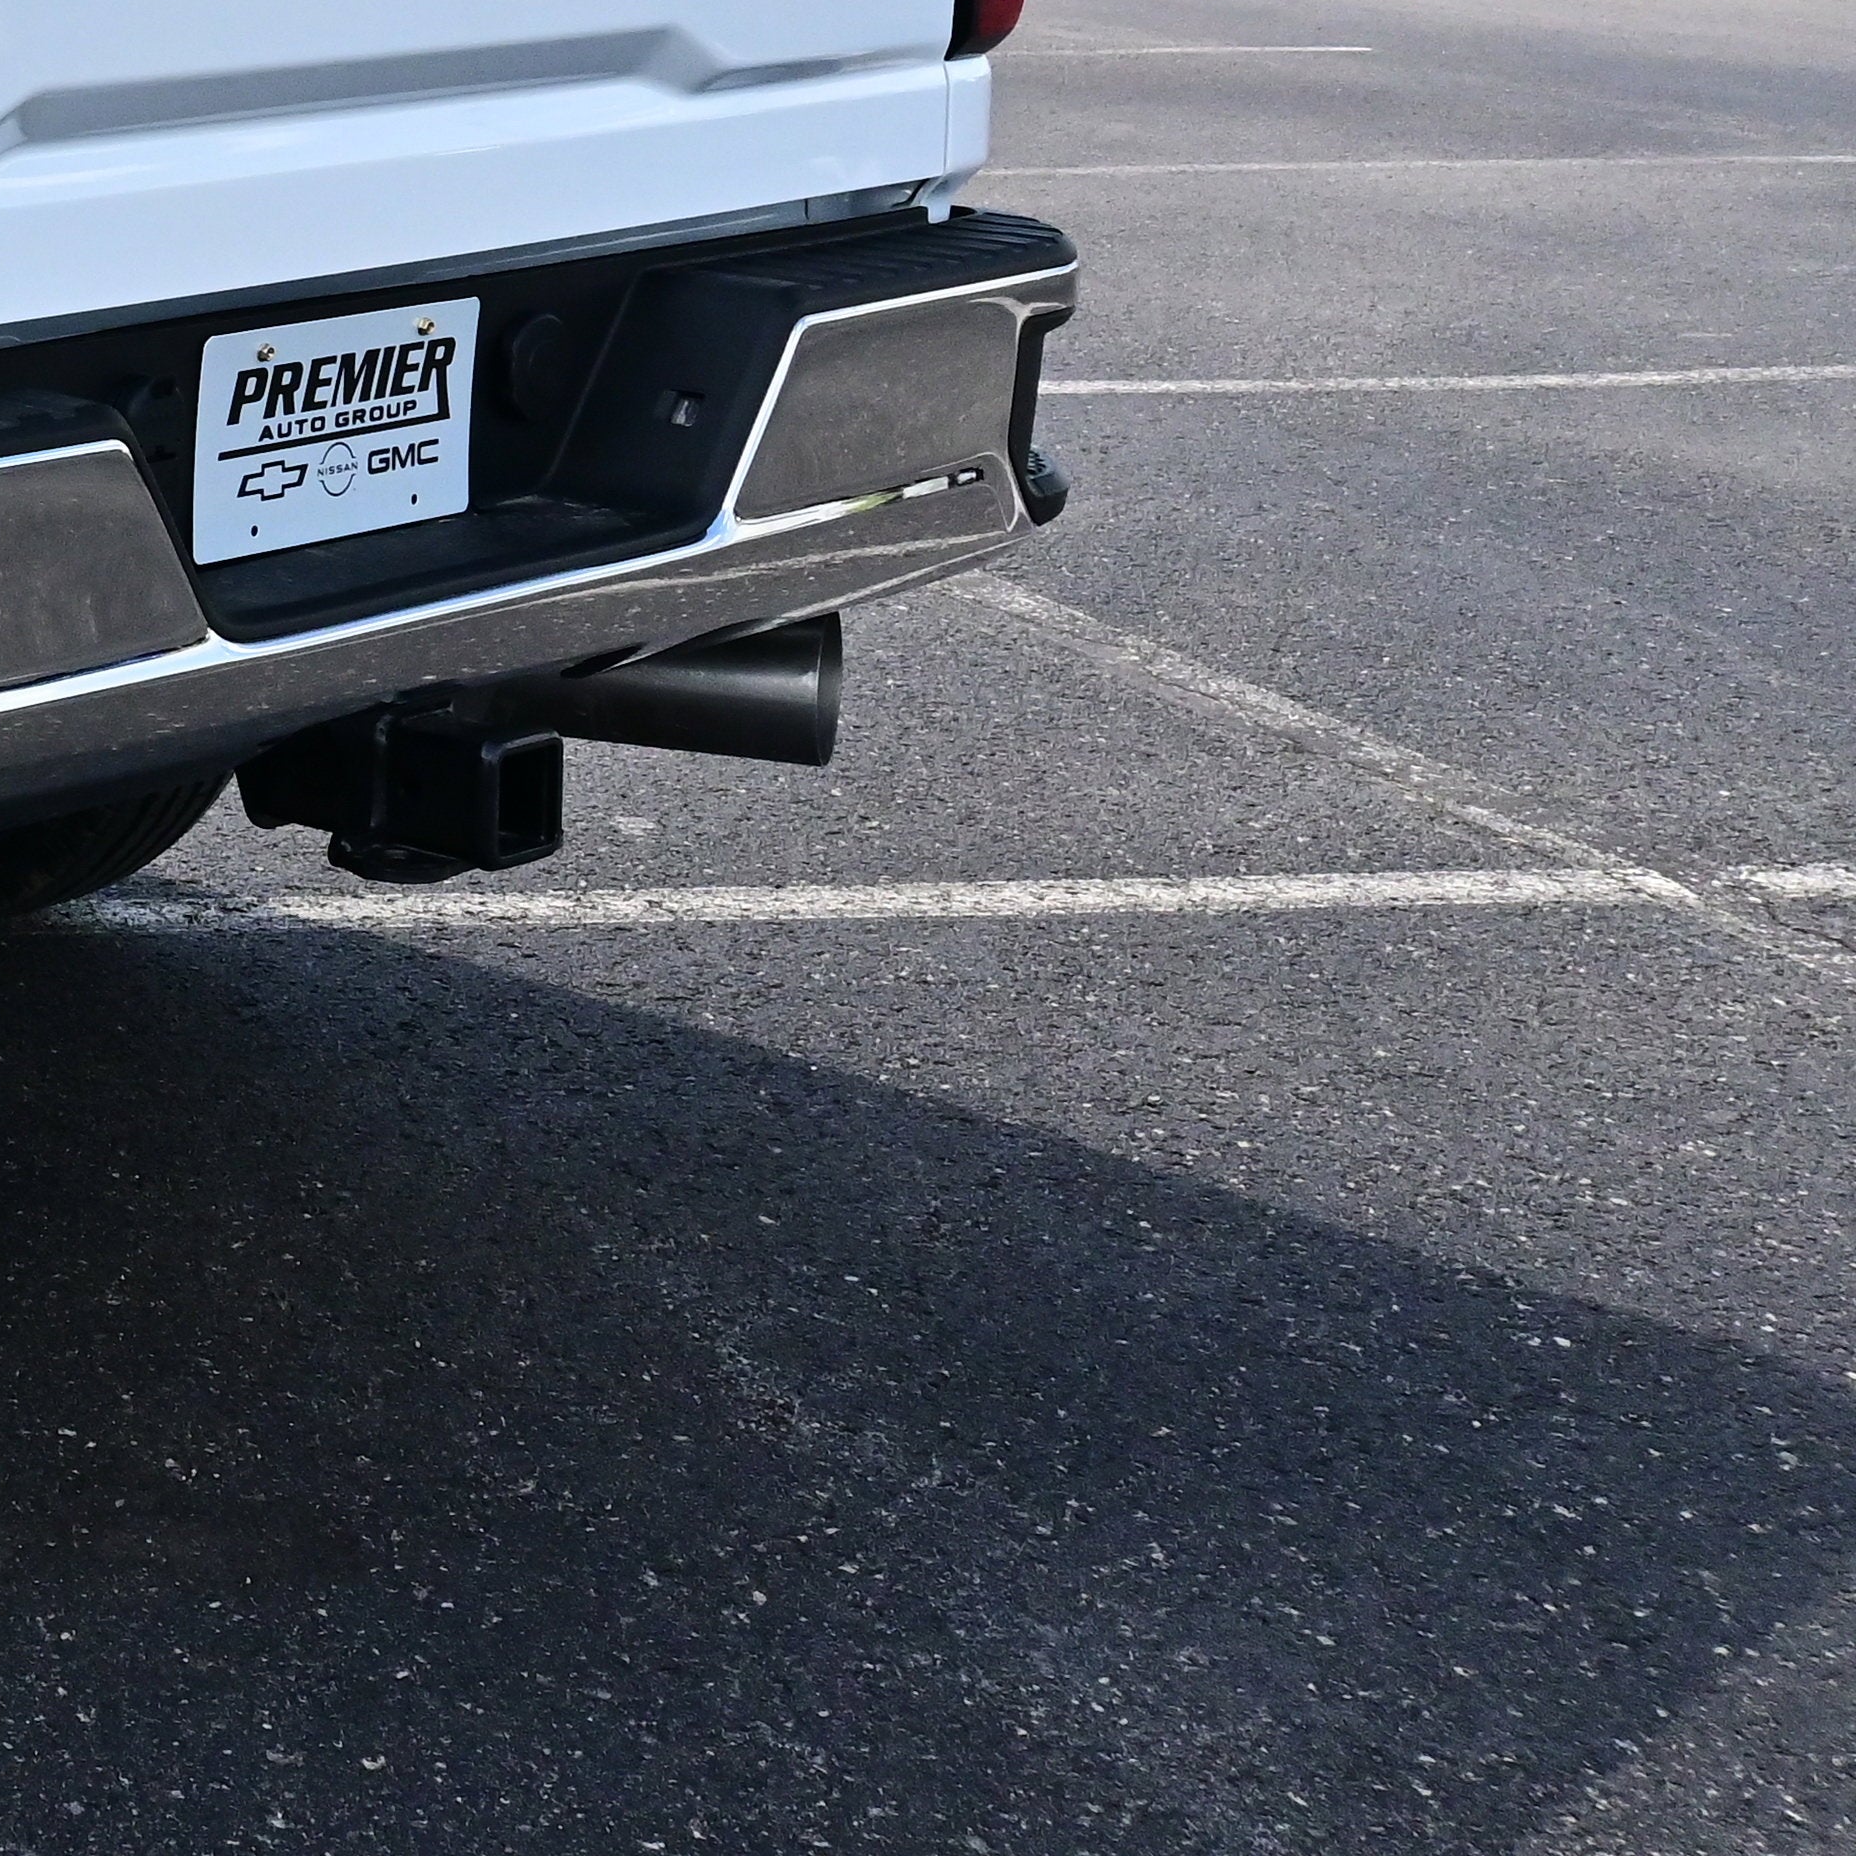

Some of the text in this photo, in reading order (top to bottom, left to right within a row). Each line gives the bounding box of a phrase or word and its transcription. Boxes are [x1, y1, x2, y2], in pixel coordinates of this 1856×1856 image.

[226, 336, 456, 427] PREMIER
[258, 399, 418, 442] AUTO GROUP
[317, 438, 439, 477] NISSAN GMC
